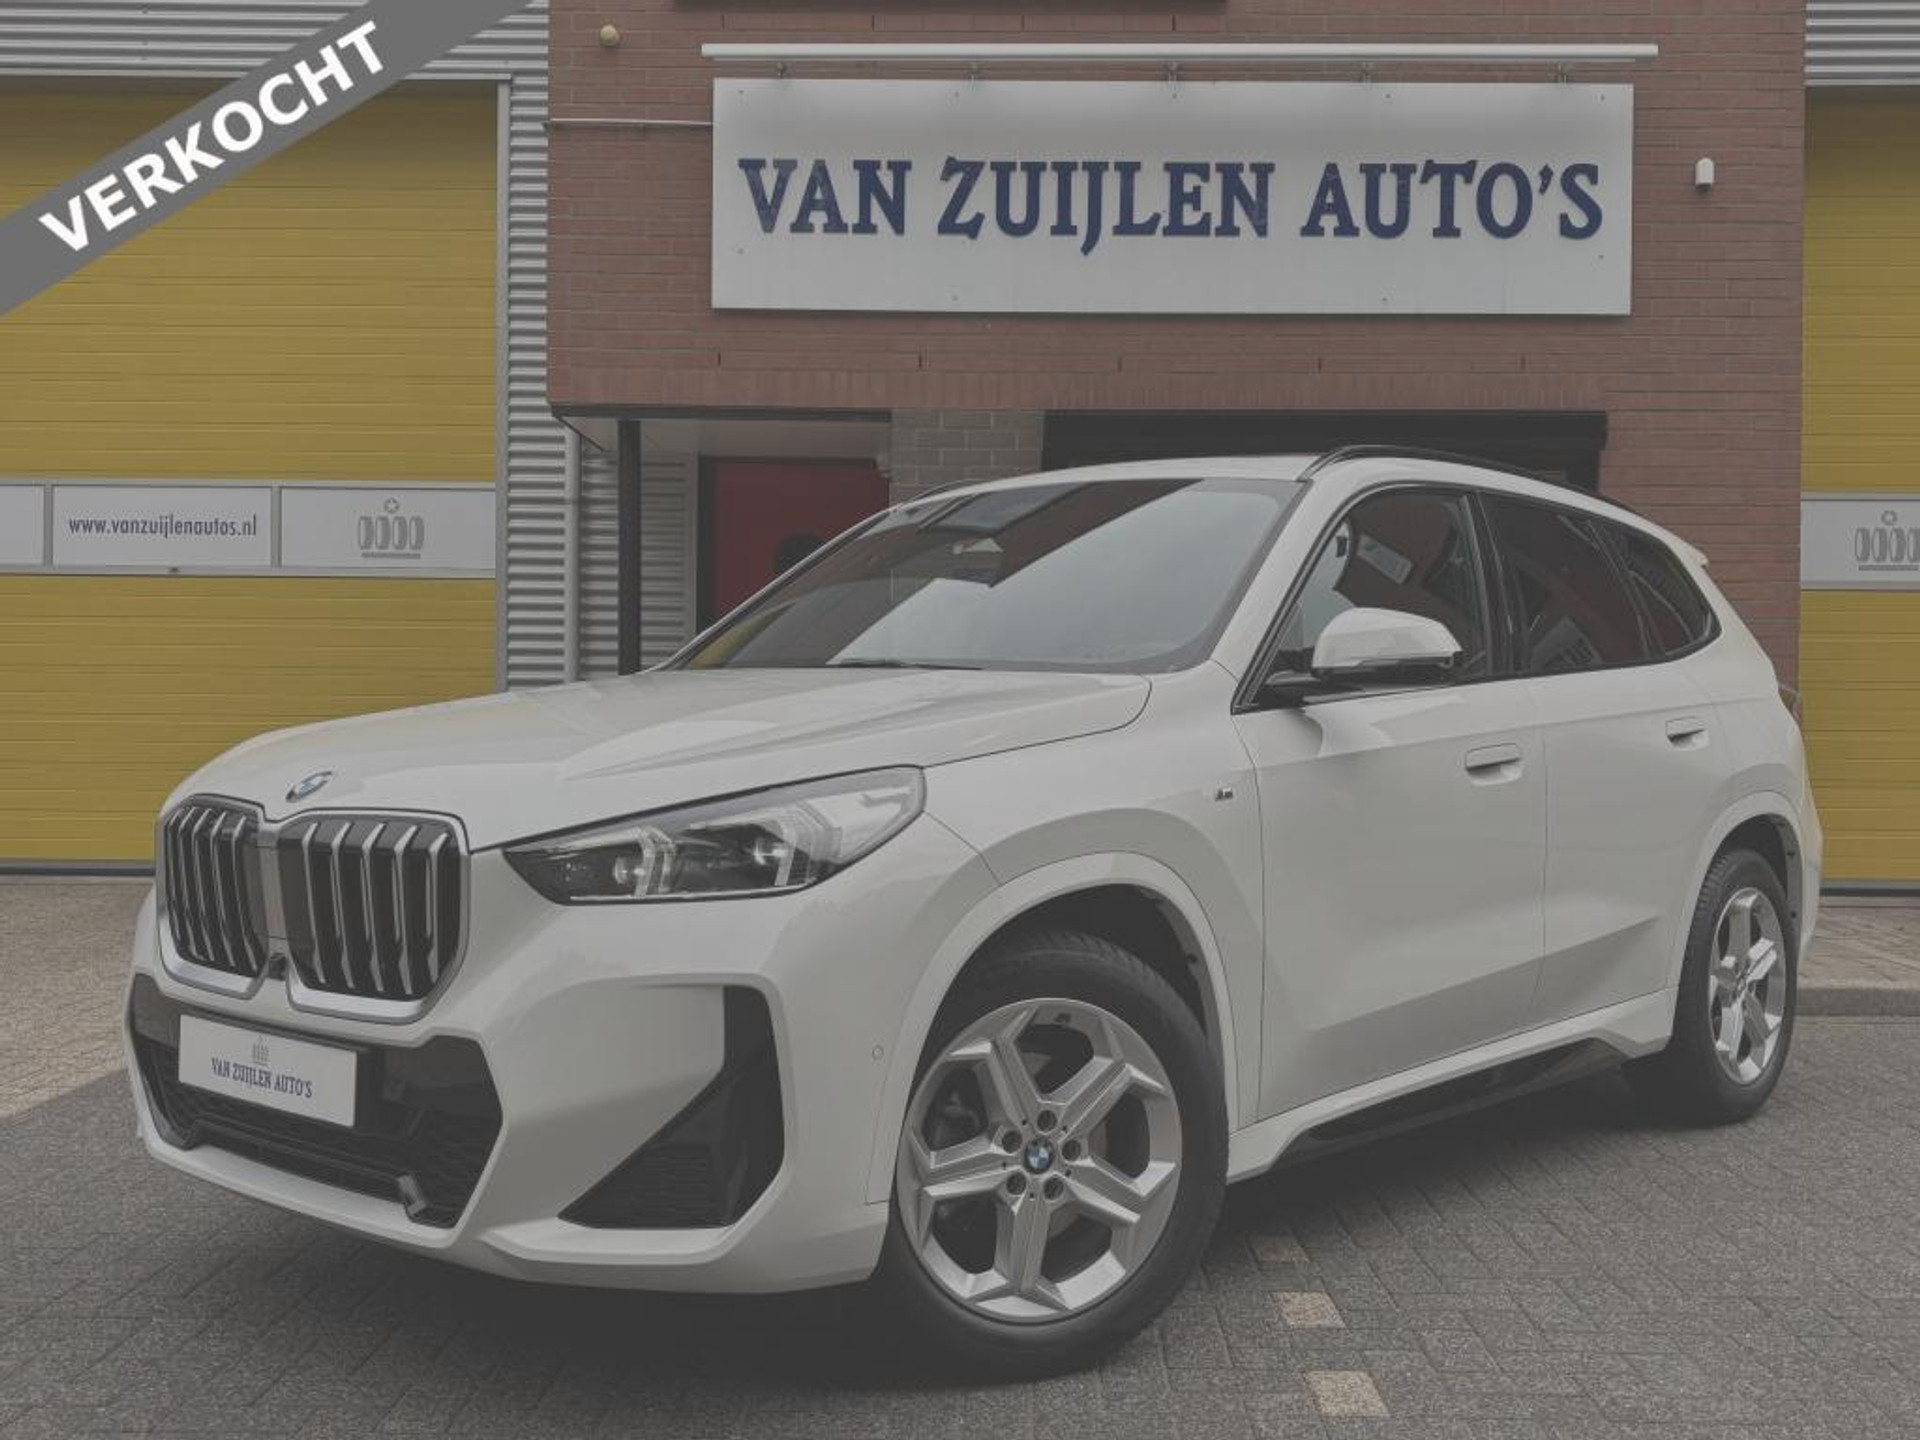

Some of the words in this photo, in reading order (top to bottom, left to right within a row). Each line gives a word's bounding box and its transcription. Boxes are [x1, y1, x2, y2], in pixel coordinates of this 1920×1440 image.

[737, 157, 913, 236] VAN
[937, 155, 1275, 257] ZUIJLEN
[1299, 158, 1604, 241] AUTO'S
[68, 513, 257, 540] www.vanzuijlenautos.nl
[210, 1056, 231, 1079] VAN
[232, 1062, 273, 1090] ZUIJLEN
[273, 1073, 313, 1099] AUTO'S
